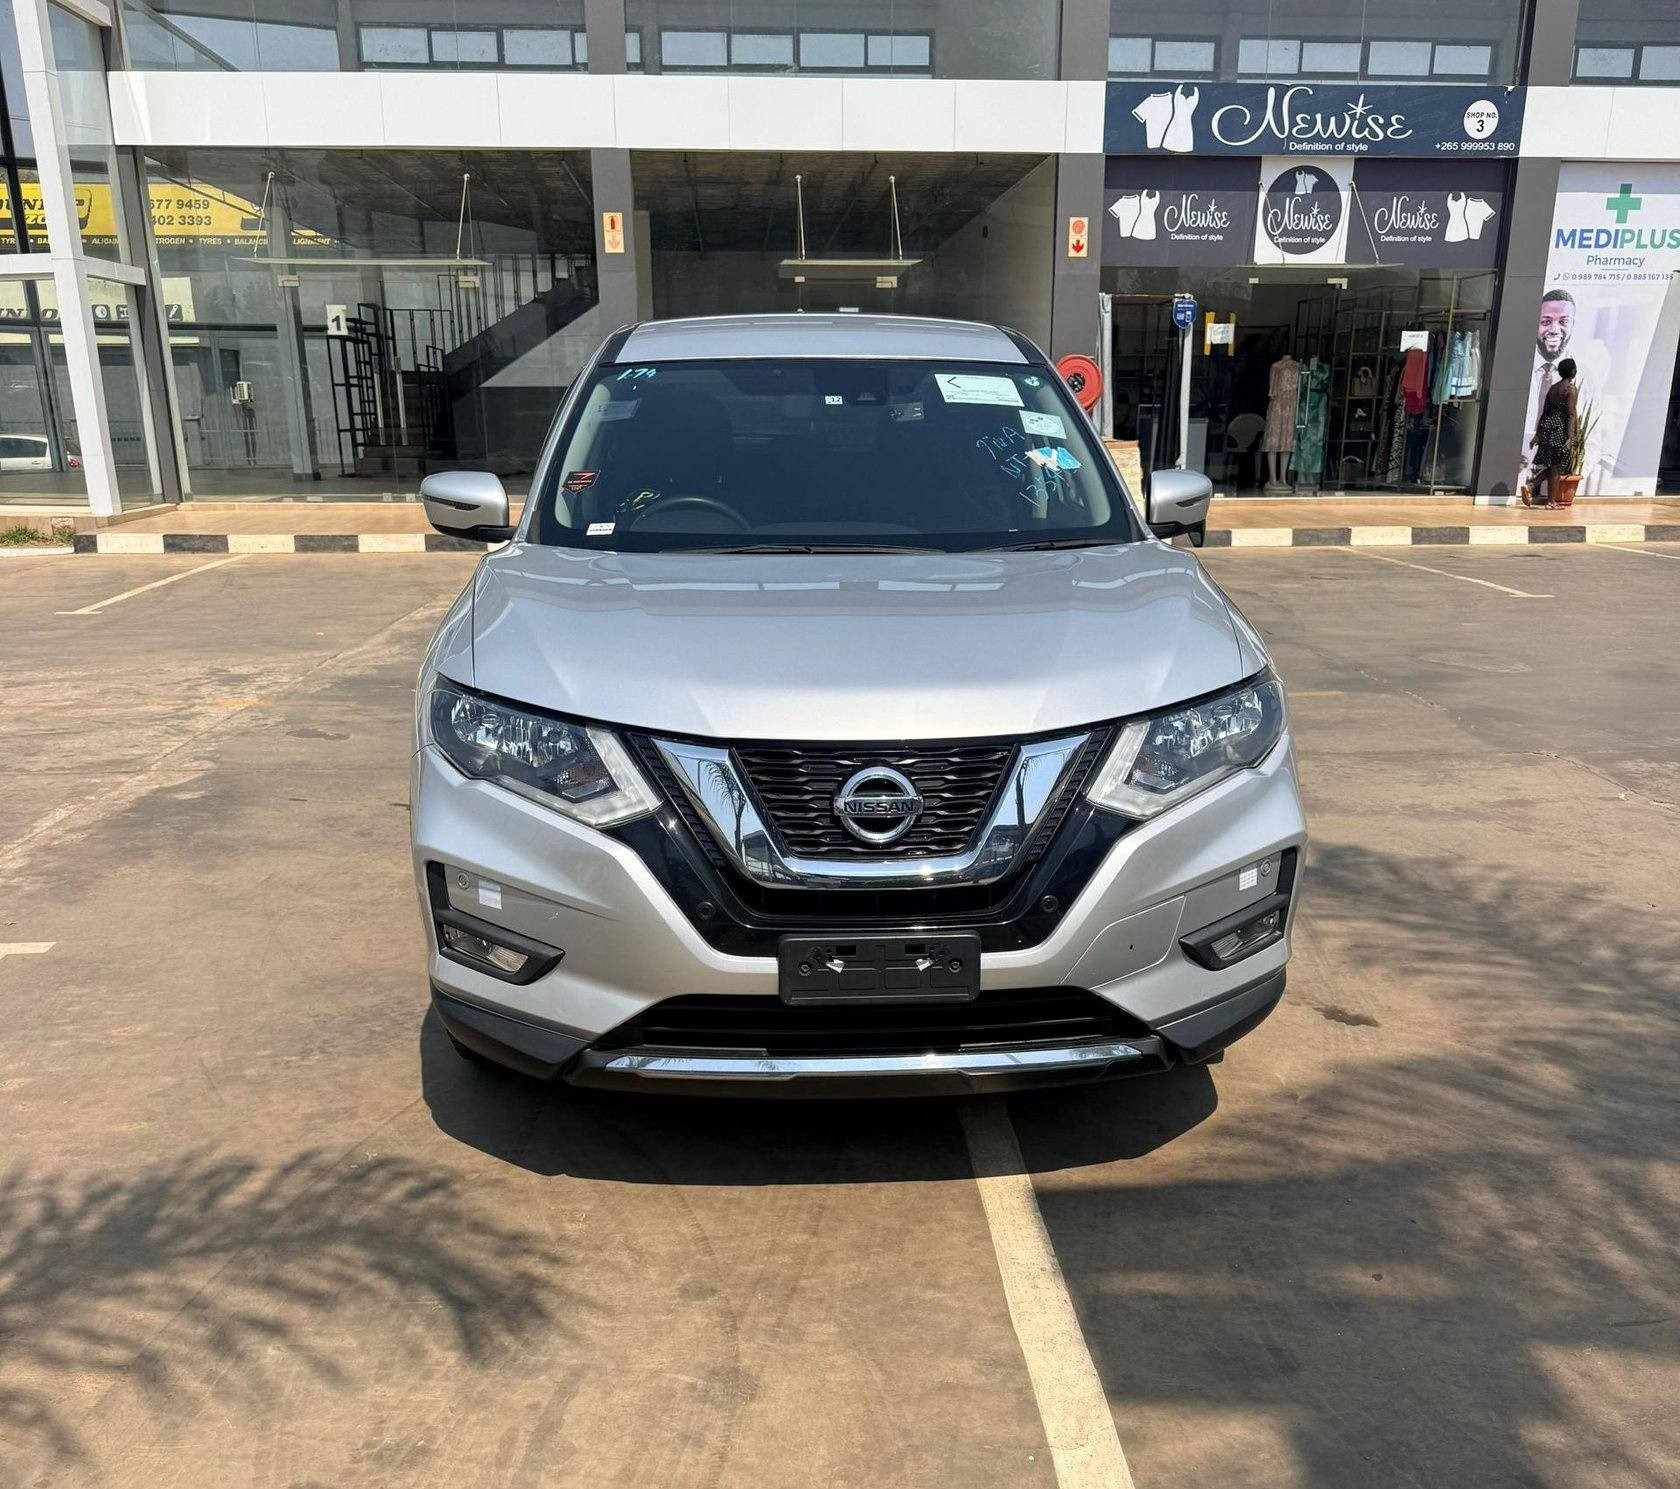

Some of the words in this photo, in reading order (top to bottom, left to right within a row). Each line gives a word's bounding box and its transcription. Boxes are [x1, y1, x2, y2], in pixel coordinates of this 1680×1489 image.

[1476, 119, 1484, 132] 3
[1289, 142, 1333, 151] Definition
[1335, 142, 1345, 151] of
[1346, 142, 1368, 153] style
[1435, 142, 1459, 151] +265
[1461, 142, 1495, 151] 999953
[1497, 142, 1515, 151] 890
[176, 199, 210, 209] 9459
[178, 215, 212, 225] 3393
[1208, 234, 1224, 242] style
[1310, 236, 1326, 245] style
[1417, 235, 1432, 243] style
[1555, 228, 1680, 249] MEDIPLUS
[1586, 255, 1645, 267] Pharmacy
[332, 315, 342, 331] 1
[843, 801, 914, 813] NISSAN
